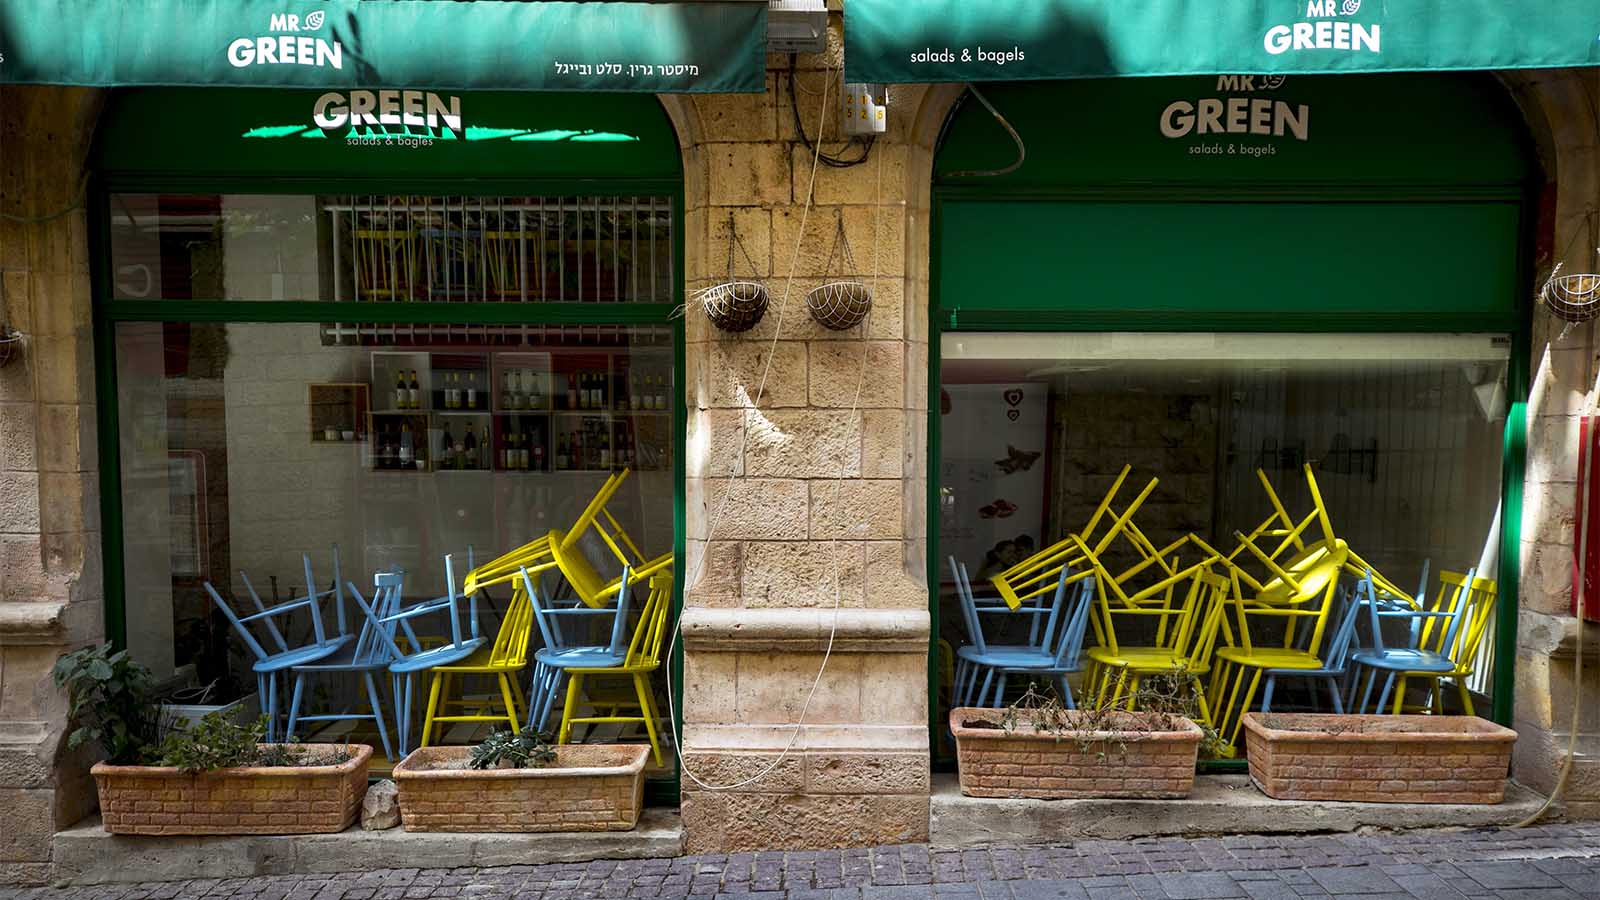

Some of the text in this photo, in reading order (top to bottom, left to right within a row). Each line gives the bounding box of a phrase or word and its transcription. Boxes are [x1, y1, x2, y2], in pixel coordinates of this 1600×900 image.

[1306, 0, 1337, 17] MR
[269, 13, 300, 31] MR
[1263, 21, 1380, 54] GREEN
[227, 36, 342, 69] GREEN
[910, 46, 1025, 65] salads & bagels
[554, 61, 592, 75] ובייגל
[596, 61, 622, 75] סלט
[657, 63, 699, 76] מיסטר
[1216, 75, 1255, 91] MR
[313, 90, 461, 131] GREEN
[1159, 98, 1309, 141] GREEN
[346, 136, 382, 146] salads
[1189, 144, 1223, 155] salads
[1240, 143, 1276, 157] bagels
